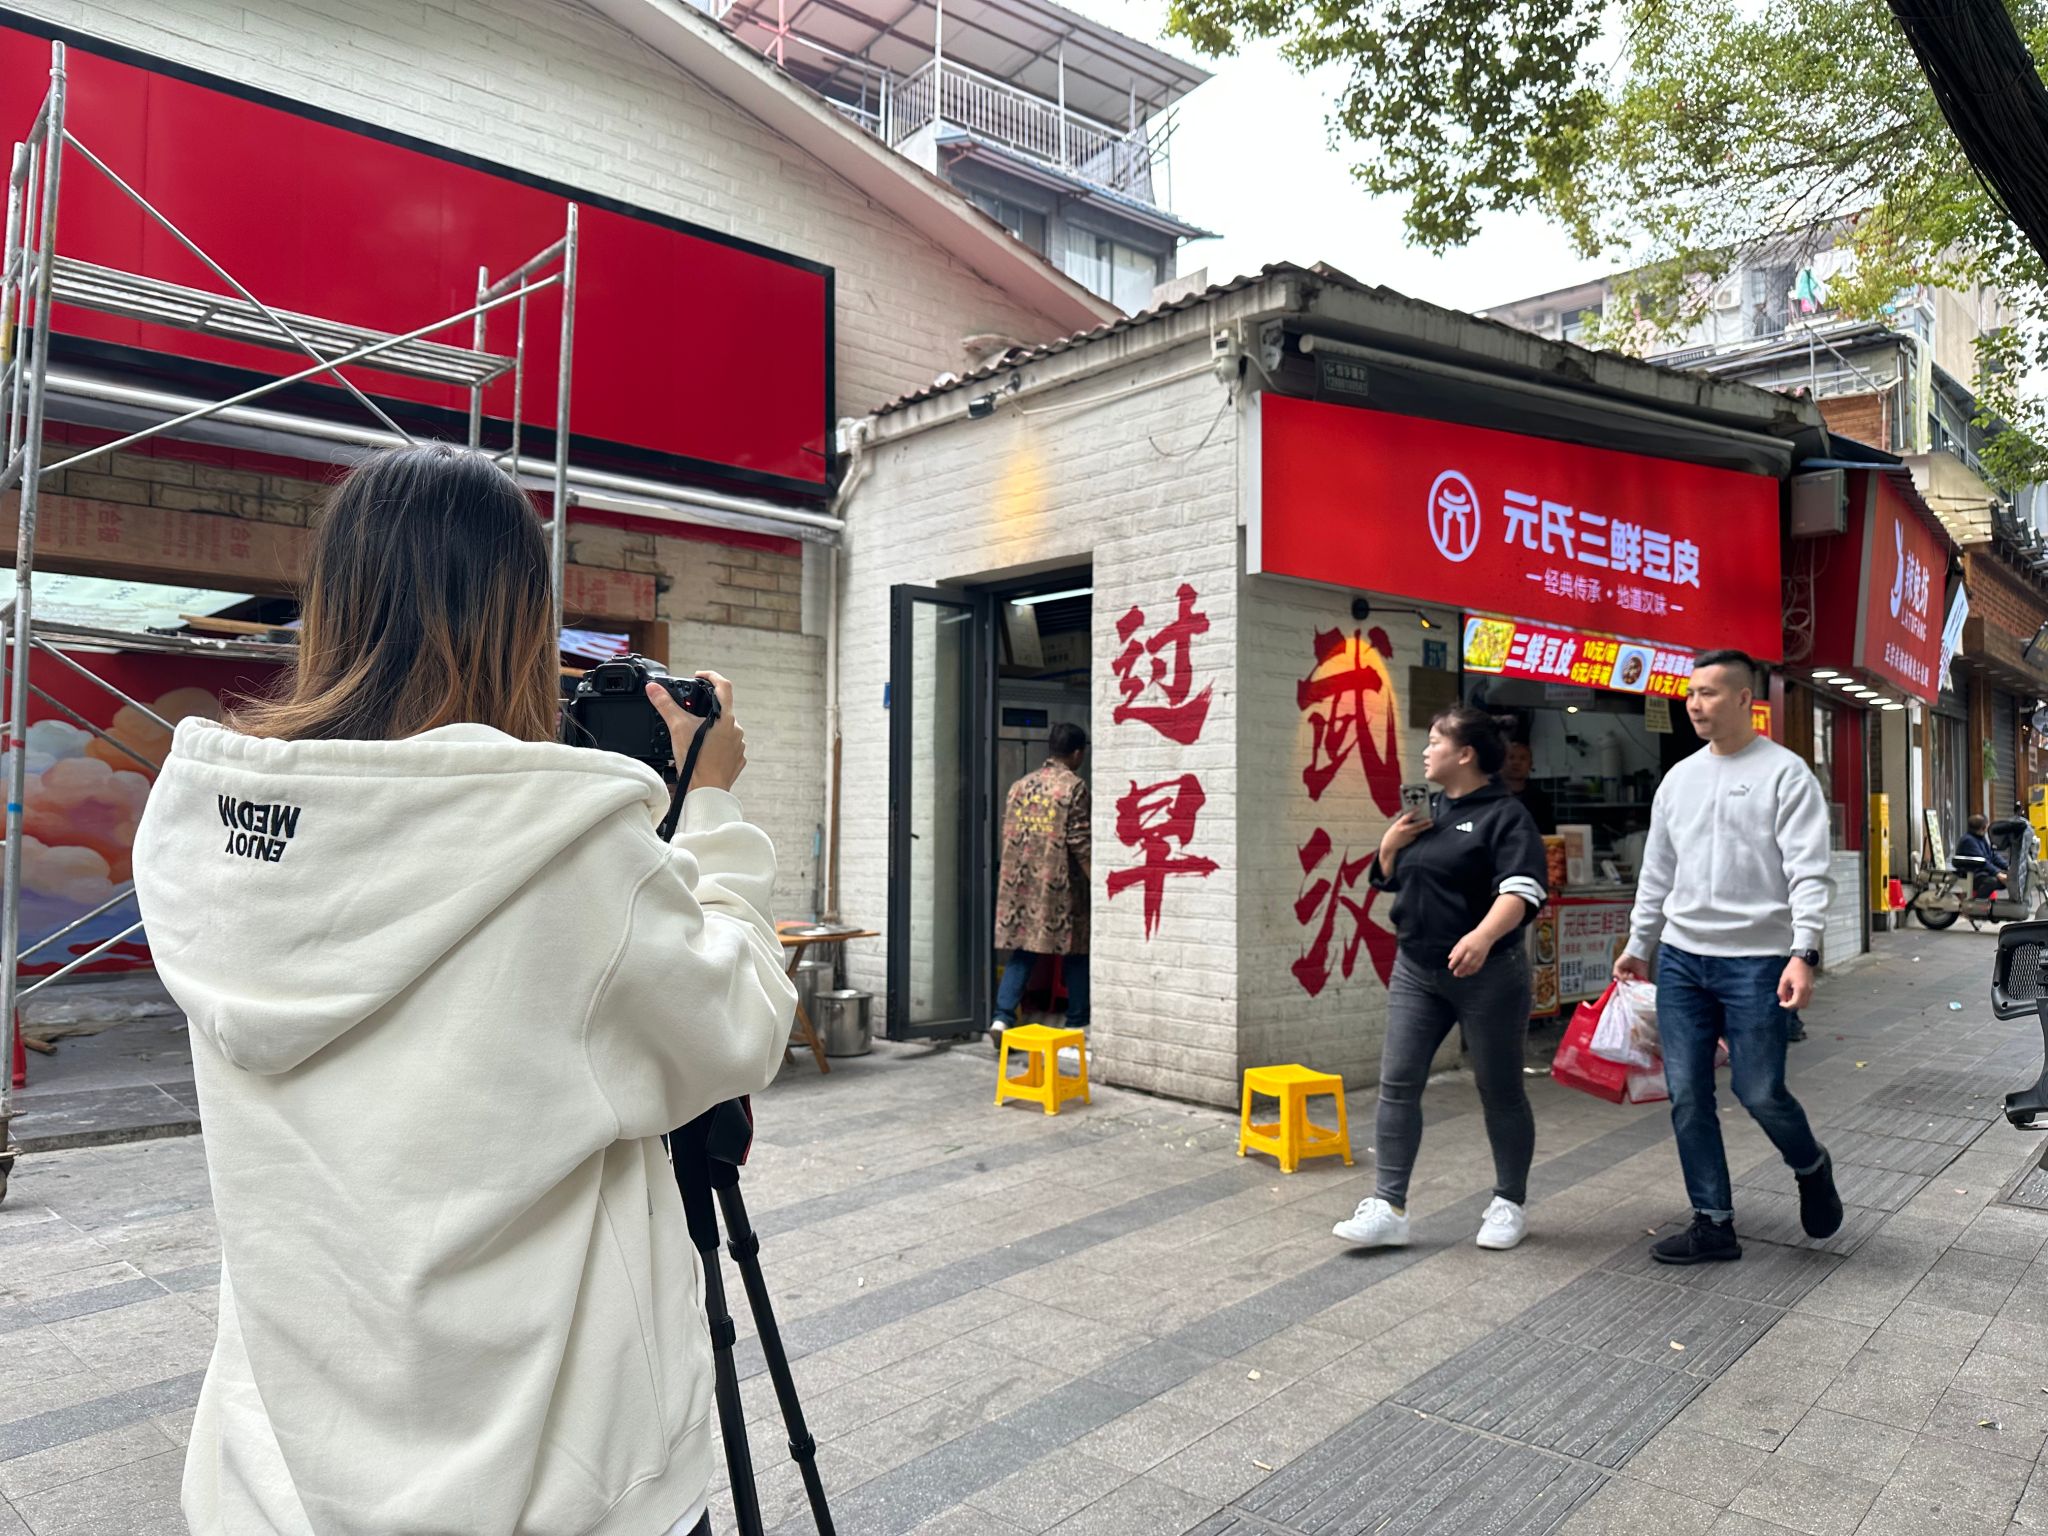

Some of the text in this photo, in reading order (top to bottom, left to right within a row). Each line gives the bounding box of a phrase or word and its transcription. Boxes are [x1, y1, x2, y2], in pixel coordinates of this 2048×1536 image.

[1503, 489, 1700, 588] 元氏三鲜豆皮
[1904, 550, 1929, 618] 辣兔坊
[1505, 633, 1577, 677] 三鲜豆皮
[1106, 583, 1220, 942] 过早
[218, 794, 301, 839] MEDM
[1291, 624, 1403, 998] 武汉
[225, 830, 287, 862] ENJOY
